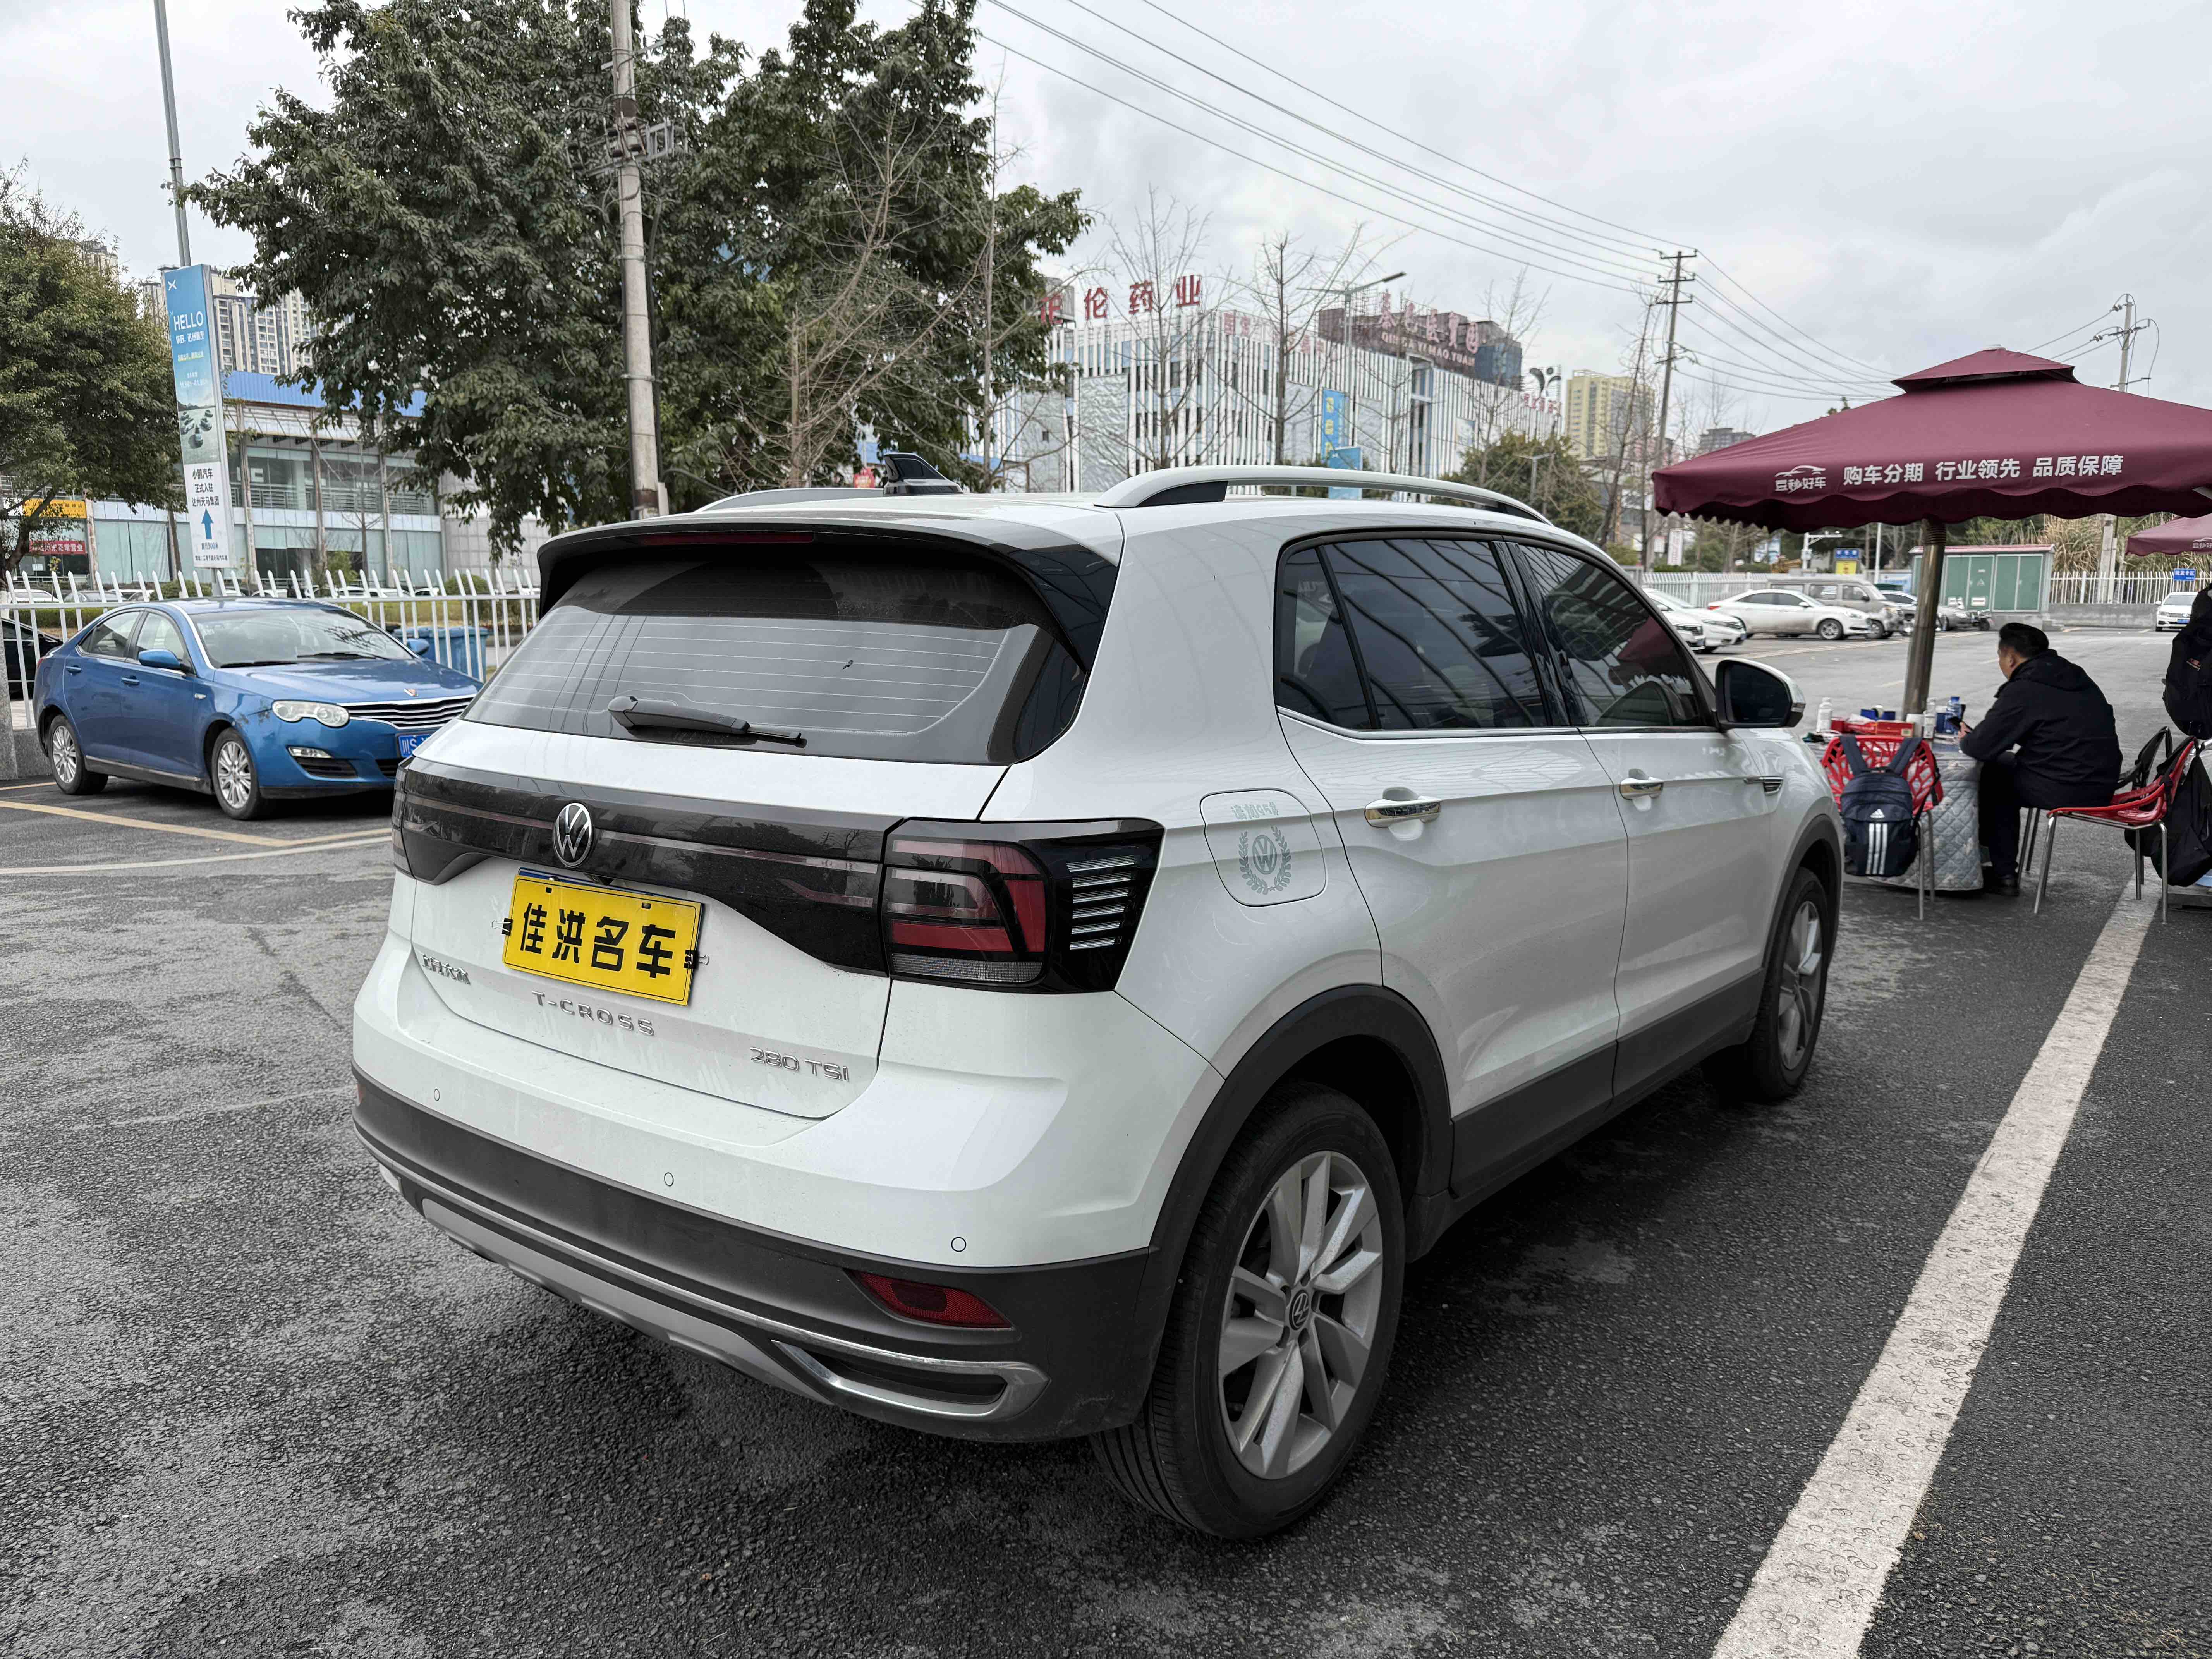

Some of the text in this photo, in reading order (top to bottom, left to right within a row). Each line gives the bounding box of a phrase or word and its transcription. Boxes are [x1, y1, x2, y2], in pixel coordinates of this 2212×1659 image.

[173, 311, 204, 331] HELLO
[192, 467, 213, 480] 小鹏汽车
[1843, 462, 1924, 486] 购车分期
[1936, 458, 2020, 481] 行业领先
[2032, 454, 2124, 477] 品质保障
[194, 483, 213, 493] 正式入驻
[192, 496, 220, 507] 达州天马集团
[520, 902, 676, 979] 佳洪名车
[531, 991, 654, 1037] T-CROSS
[749, 1046, 849, 1082] 280 TSI
